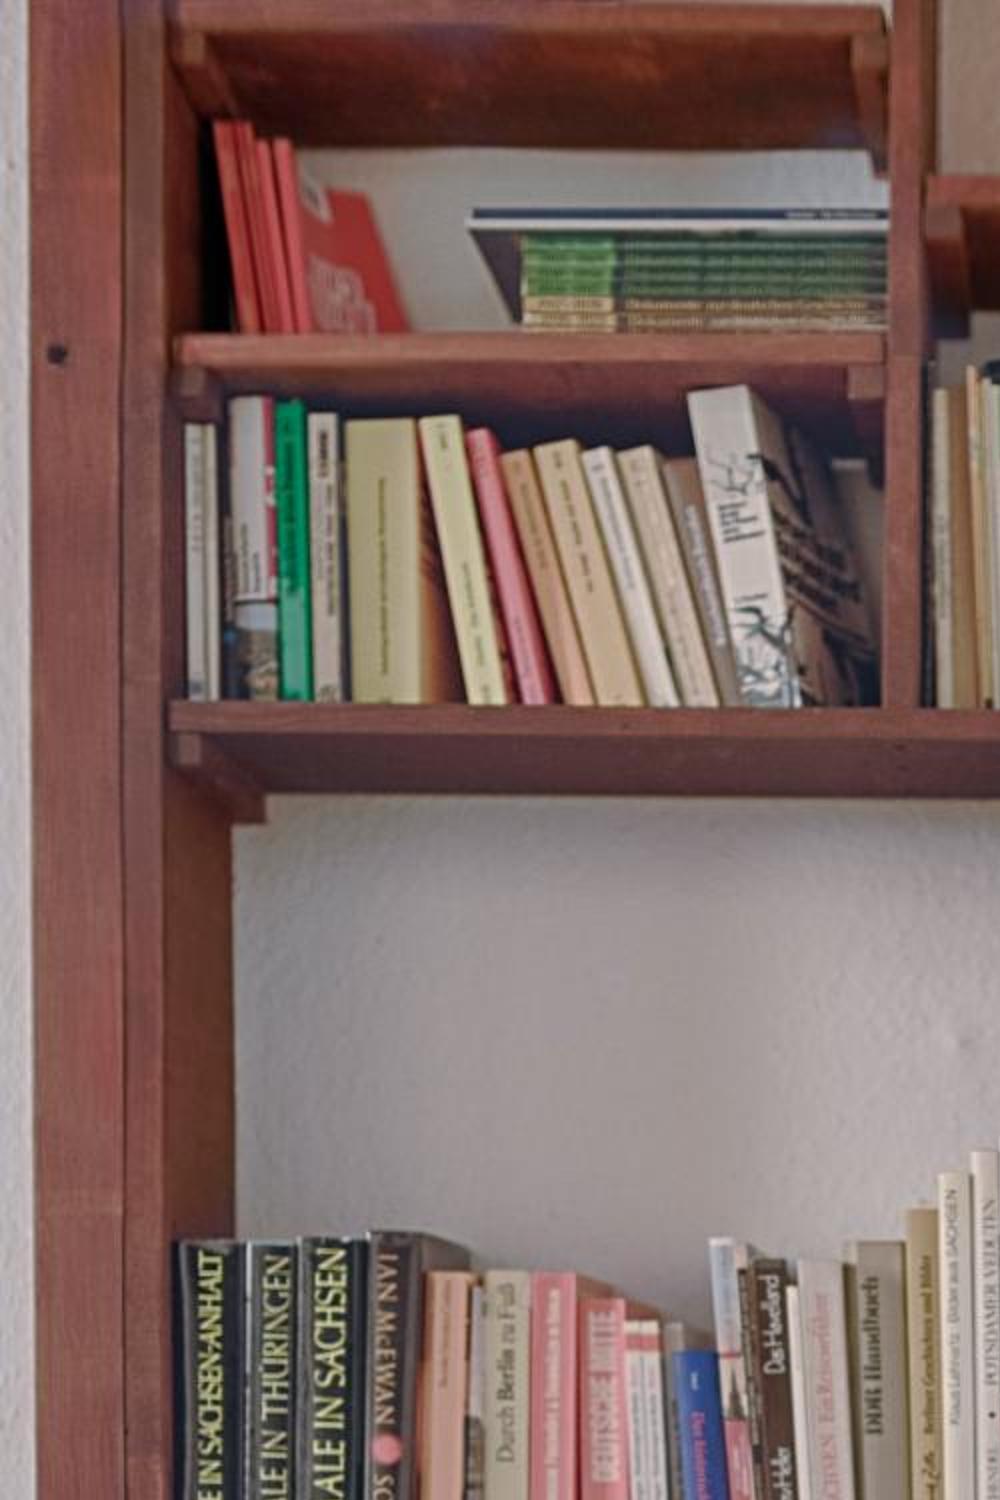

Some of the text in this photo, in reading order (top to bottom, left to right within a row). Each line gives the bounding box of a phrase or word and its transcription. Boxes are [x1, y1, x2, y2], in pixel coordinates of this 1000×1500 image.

[314, 1246, 347, 1388] SACHSEN
[374, 1253, 399, 1426] IAN McEWAN
[499, 1324, 515, 1345] zu
[196, 1250, 224, 1457] SACHSEN-ANHALT
[496, 1348, 515, 1402] Berlin
[859, 1275, 884, 1437] DDR Handbuch
[313, 1396, 345, 1430] IN
[496, 1406, 515, 1463] Durch
[258, 1430, 290, 1460] IN
[197, 1460, 224, 1486] IN
